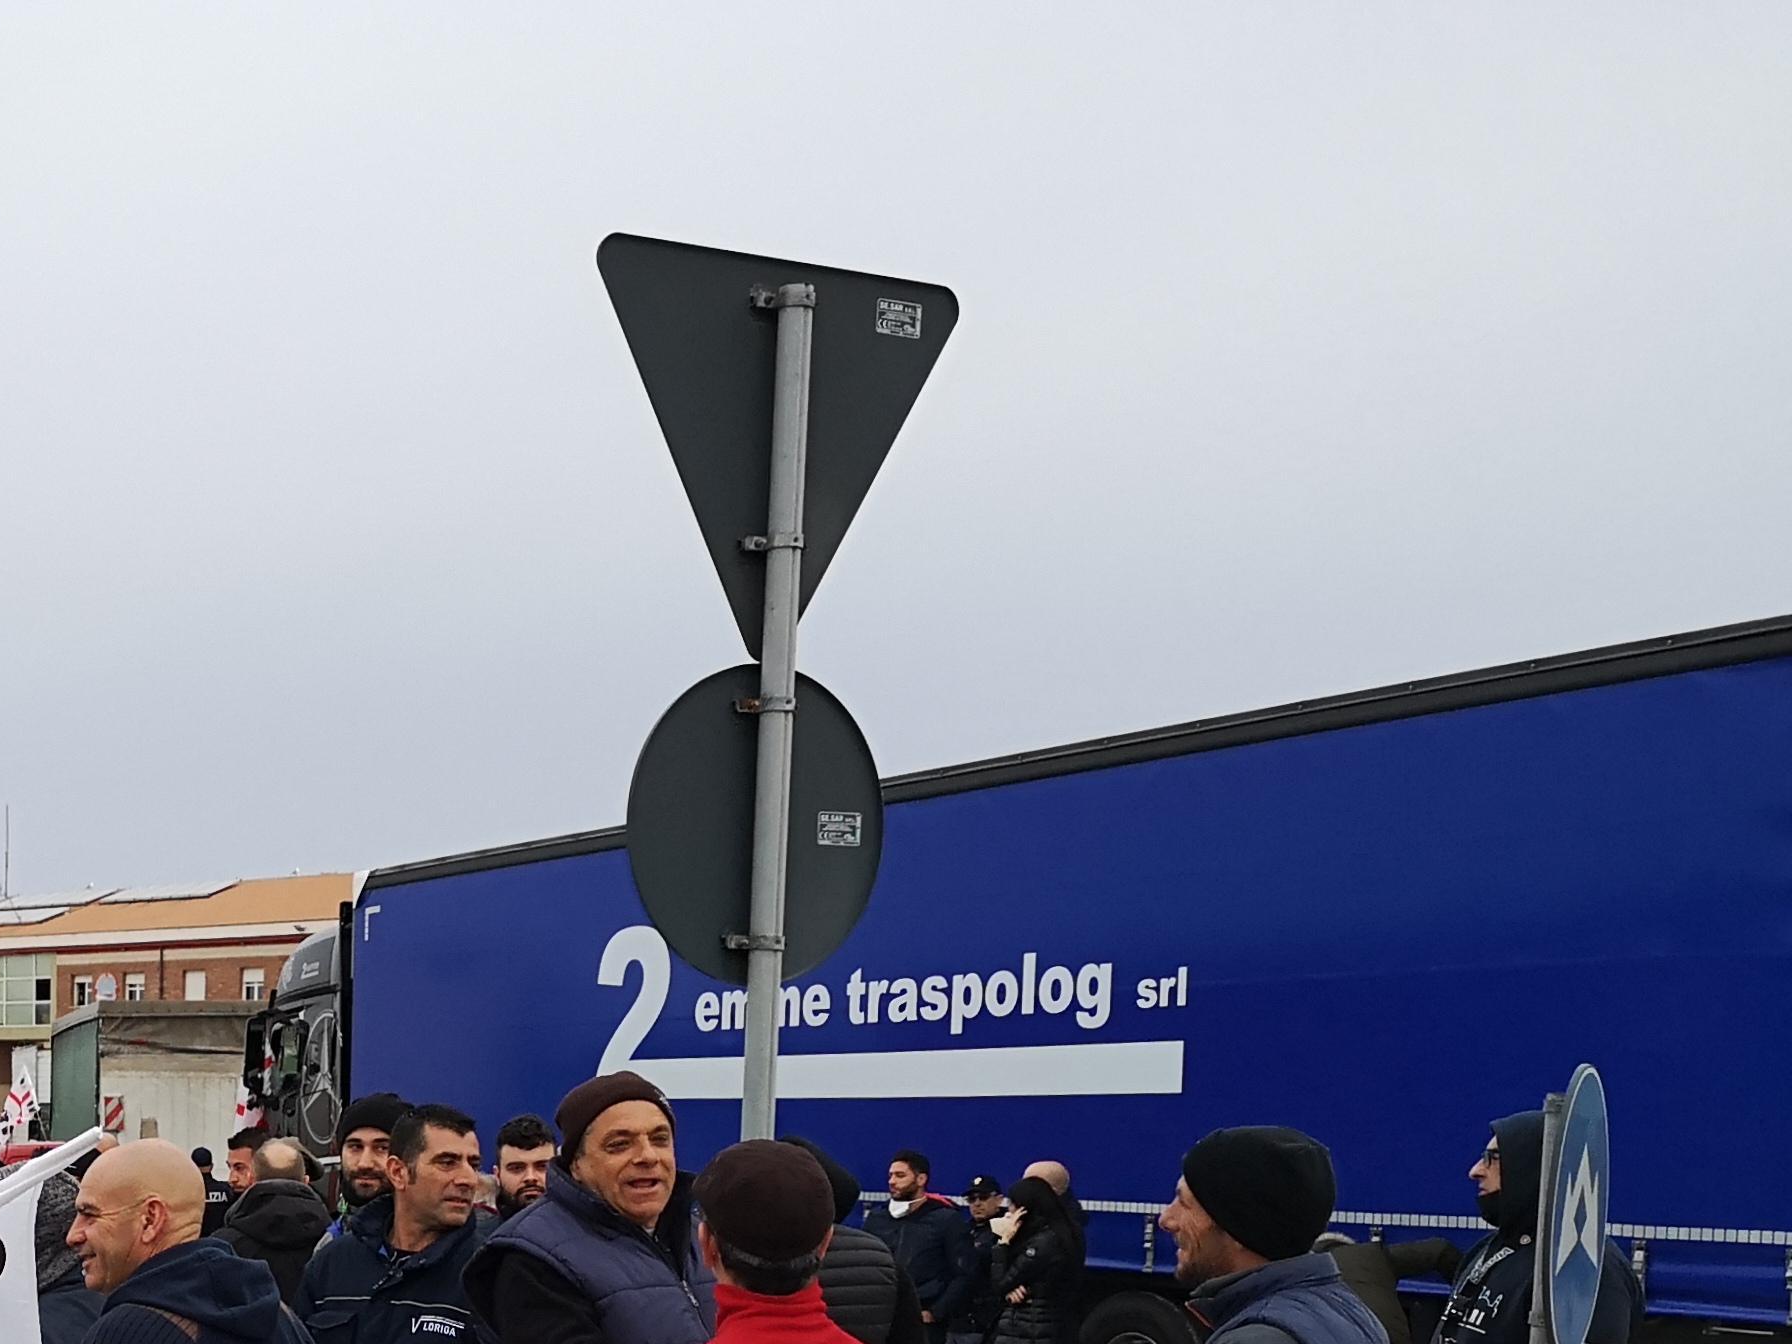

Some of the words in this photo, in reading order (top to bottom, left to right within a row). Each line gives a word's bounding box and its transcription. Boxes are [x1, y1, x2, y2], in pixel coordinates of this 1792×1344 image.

[596, 924, 672, 1092] 2
[846, 952, 1113, 1035] traspolog
[1135, 966, 1189, 1009] srl
